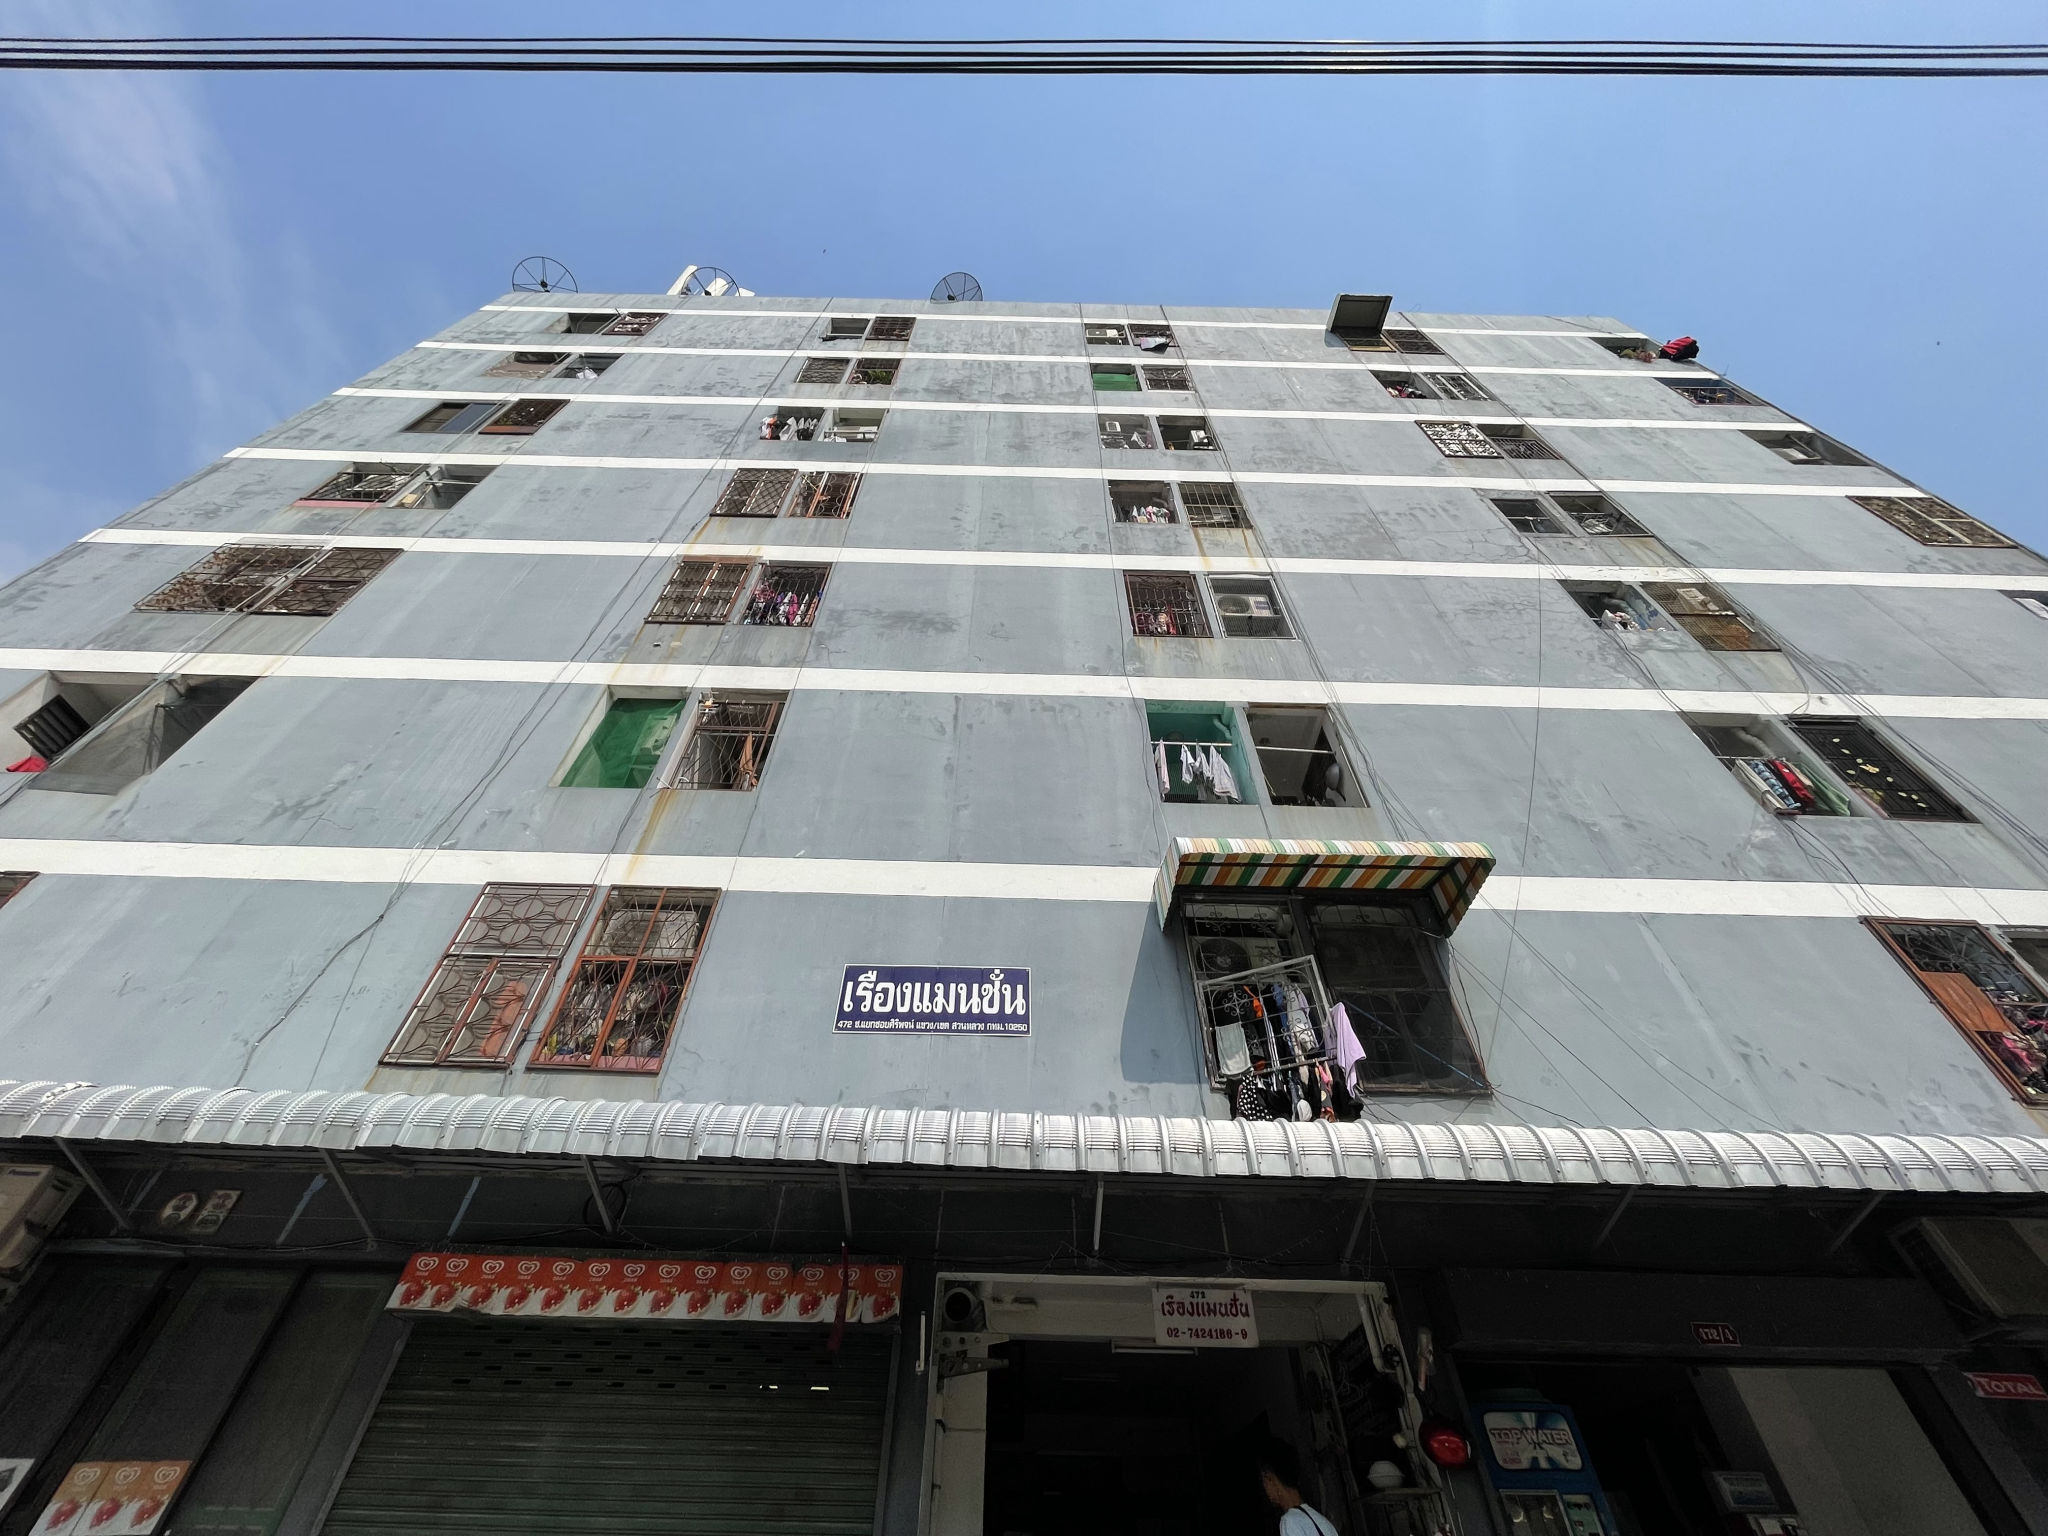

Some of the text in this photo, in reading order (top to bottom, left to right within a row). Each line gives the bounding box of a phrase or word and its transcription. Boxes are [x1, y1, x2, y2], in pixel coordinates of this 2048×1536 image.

[843, 968, 1026, 1016] เรืองแมนชั่น
[837, 1020, 853, 1028] 472
[1189, 1290, 1206, 1299] 472
[1975, 1377, 2047, 1395] TOTAL
[1489, 1428, 1572, 1445] TOP WATER
